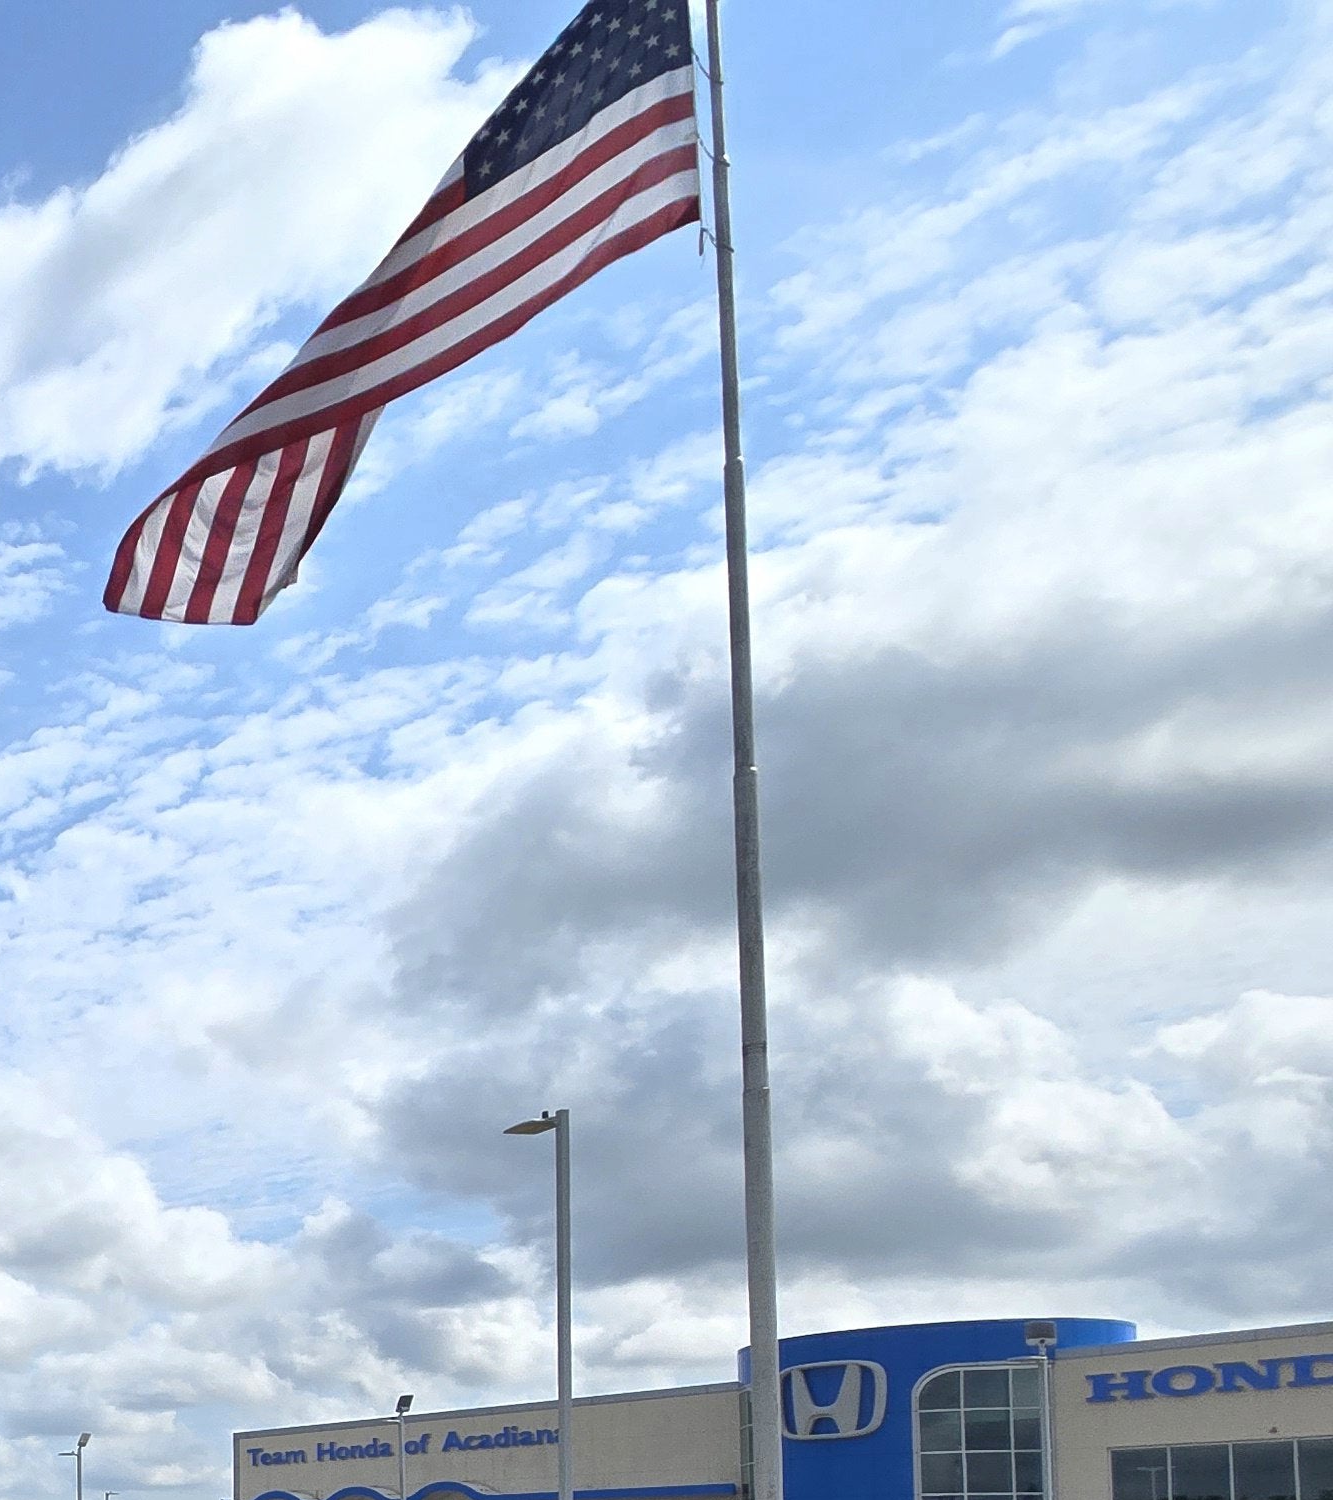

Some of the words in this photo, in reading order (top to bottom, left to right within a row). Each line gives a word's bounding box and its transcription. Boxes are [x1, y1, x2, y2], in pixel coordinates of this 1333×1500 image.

[246, 1447, 308, 1467] Team
[316, 1438, 394, 1463] Honda
[404, 1433, 431, 1455] of
